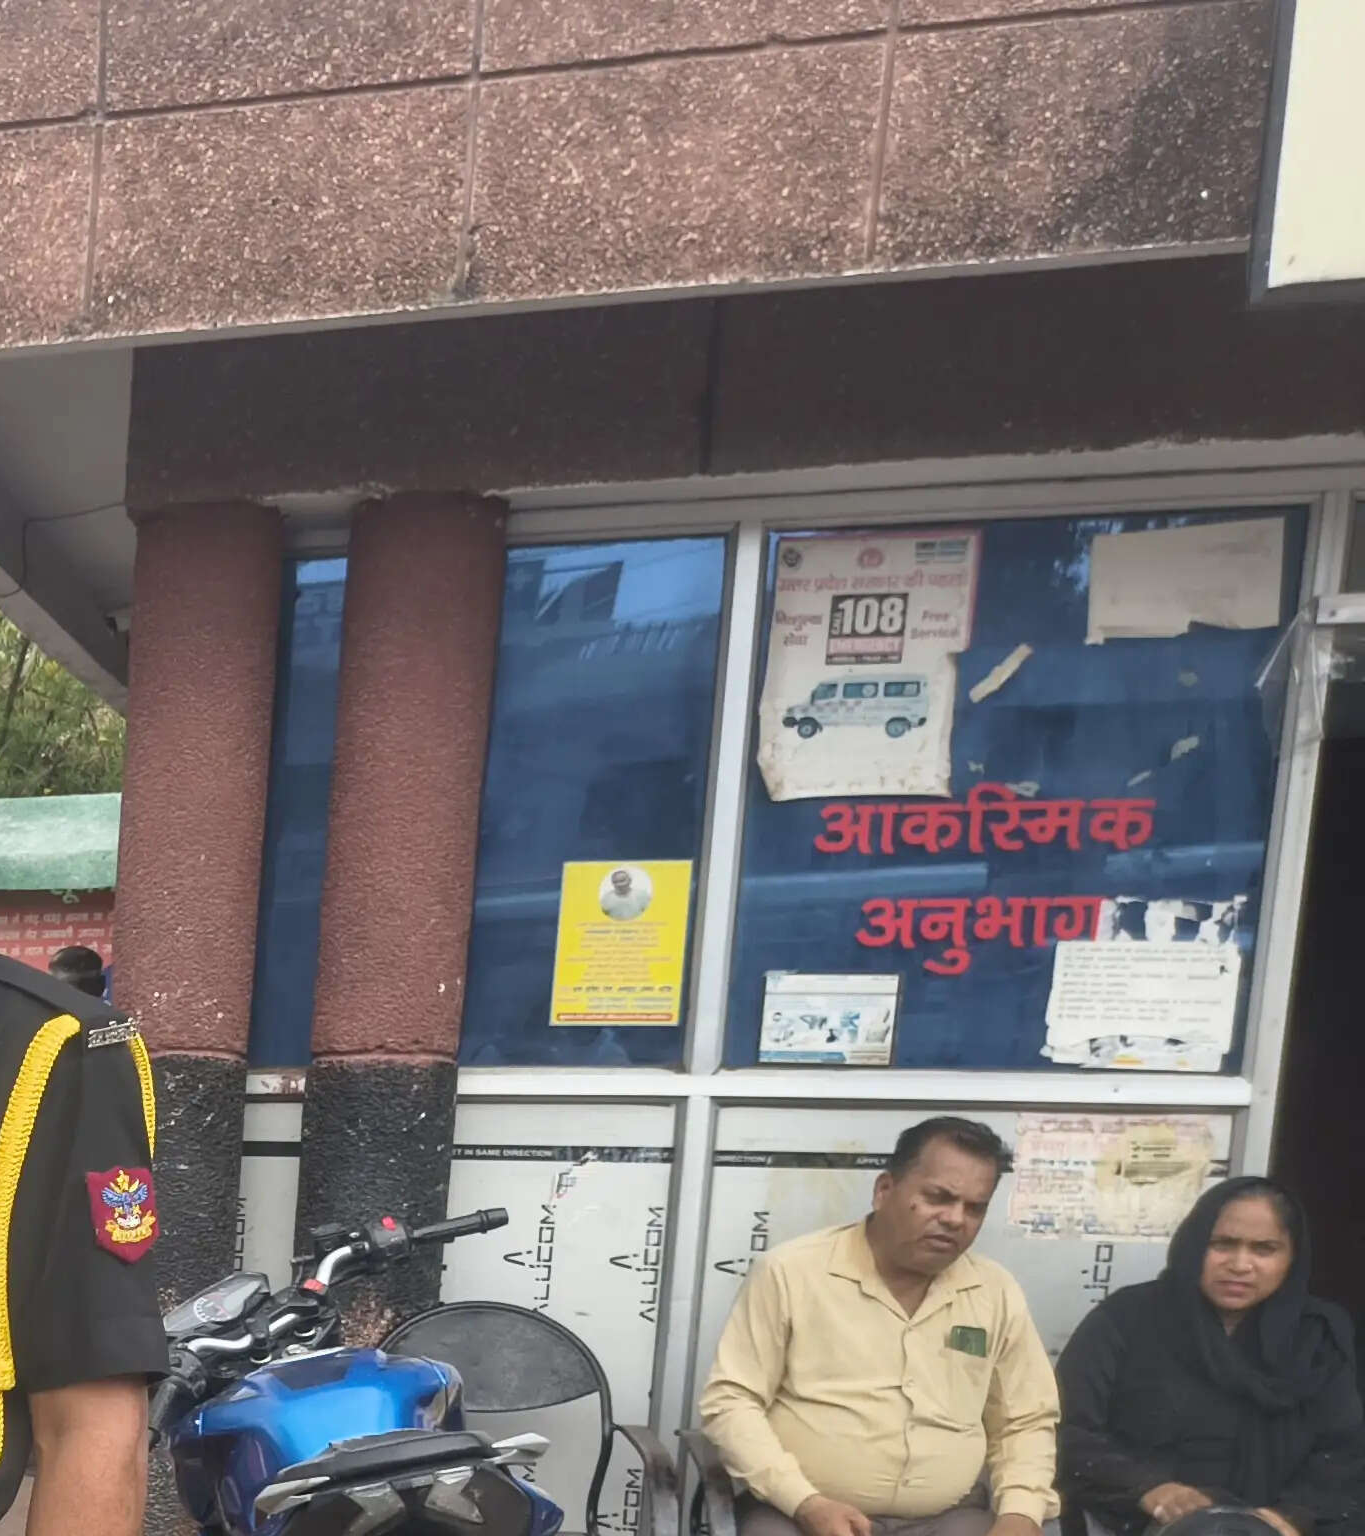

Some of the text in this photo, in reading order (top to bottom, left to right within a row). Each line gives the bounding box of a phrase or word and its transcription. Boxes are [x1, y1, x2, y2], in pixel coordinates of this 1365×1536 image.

[838, 596, 905, 635] 108
[813, 782, 1157, 855] आकस्मिक
[855, 896, 1107, 976] अनुभाग
[639, 1206, 665, 1323] ALUCOM
